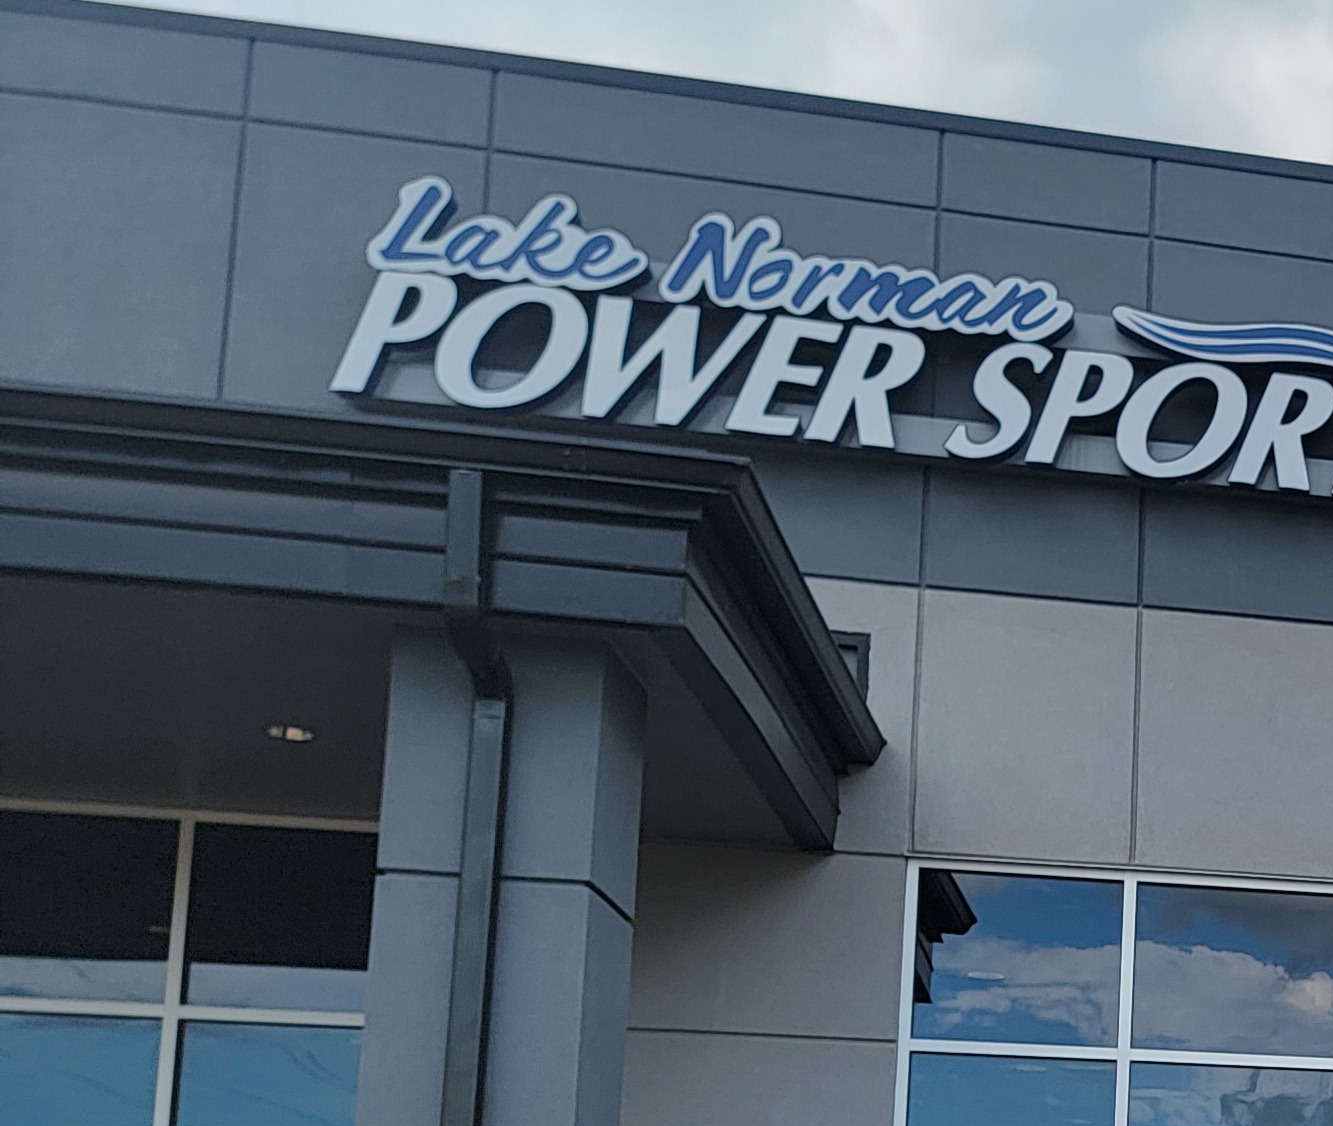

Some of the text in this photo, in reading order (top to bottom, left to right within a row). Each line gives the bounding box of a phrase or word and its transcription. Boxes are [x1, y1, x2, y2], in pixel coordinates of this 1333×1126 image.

[366, 175, 1076, 341] Lake Norman
[329, 271, 925, 448] POWER
